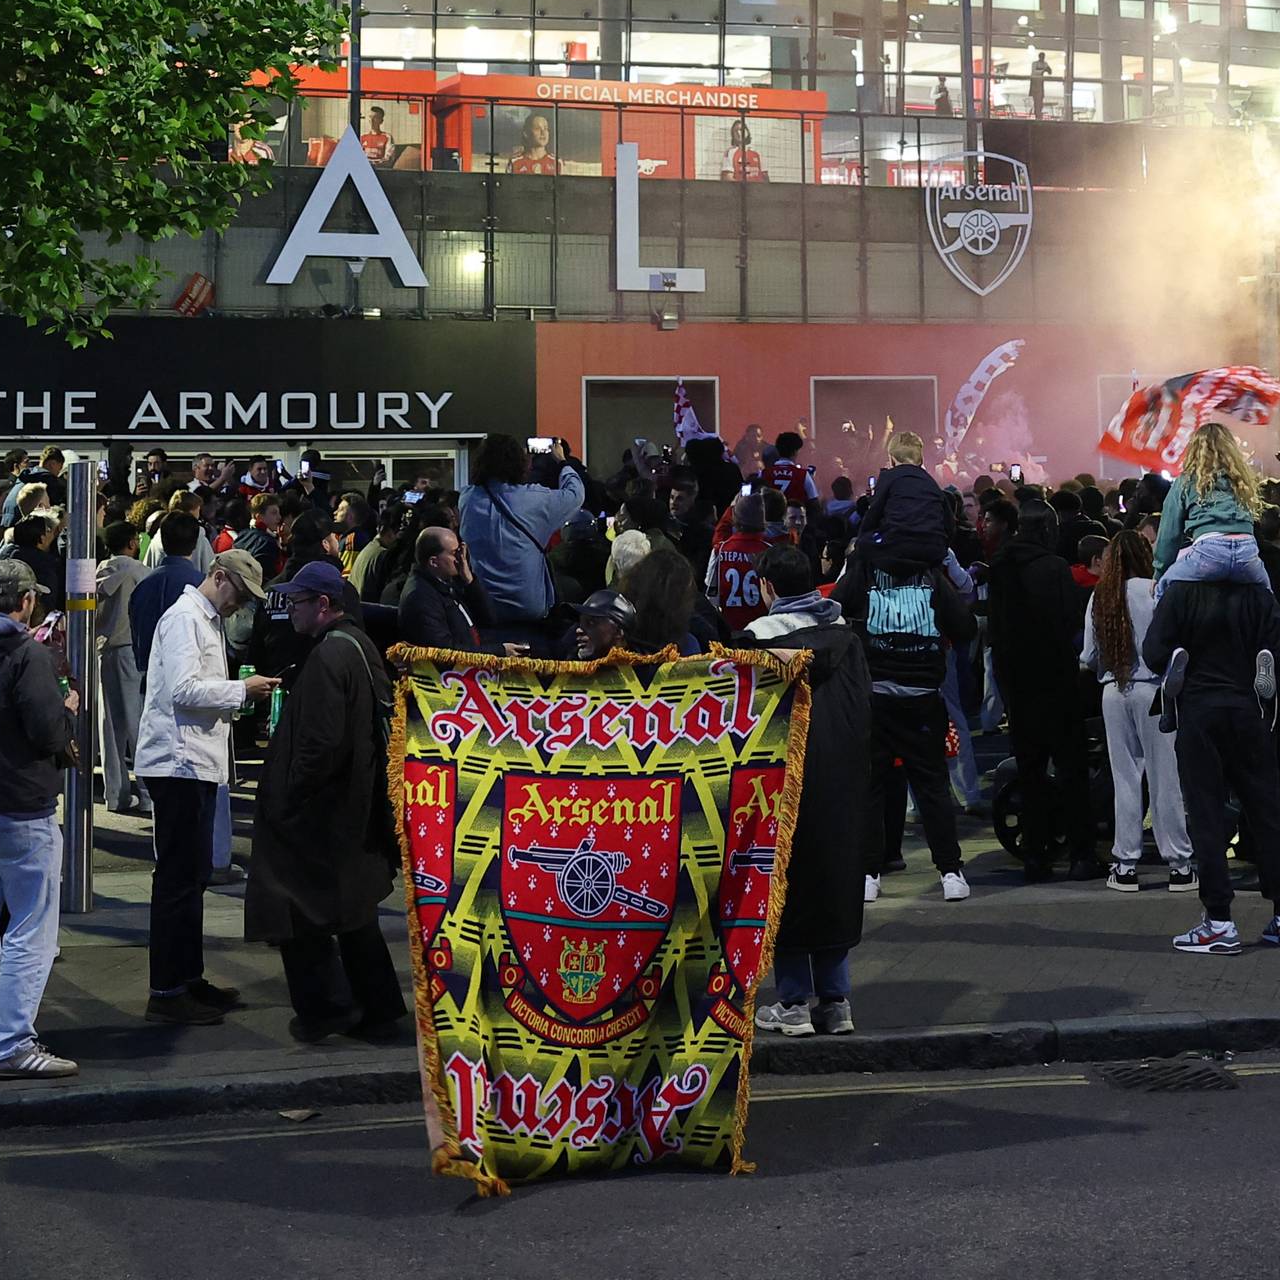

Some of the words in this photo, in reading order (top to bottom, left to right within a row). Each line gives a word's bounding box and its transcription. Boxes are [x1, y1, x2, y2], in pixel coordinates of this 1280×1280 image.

[536, 82, 622, 103] OFFICIAL
[628, 87, 759, 109] MERCHANDISE
[940, 182, 1018, 202] Arsenal
[128, 390, 454, 430] ARMOURY
[773, 479, 792, 493] 7
[725, 567, 761, 607] 26
[430, 659, 762, 752] Arsenal
[507, 779, 676, 826] Arsenal
[510, 993, 549, 1033] VICTORIA
[550, 1024, 605, 1045] CONCORDIA
[605, 1009, 642, 1038] CRESCIT
